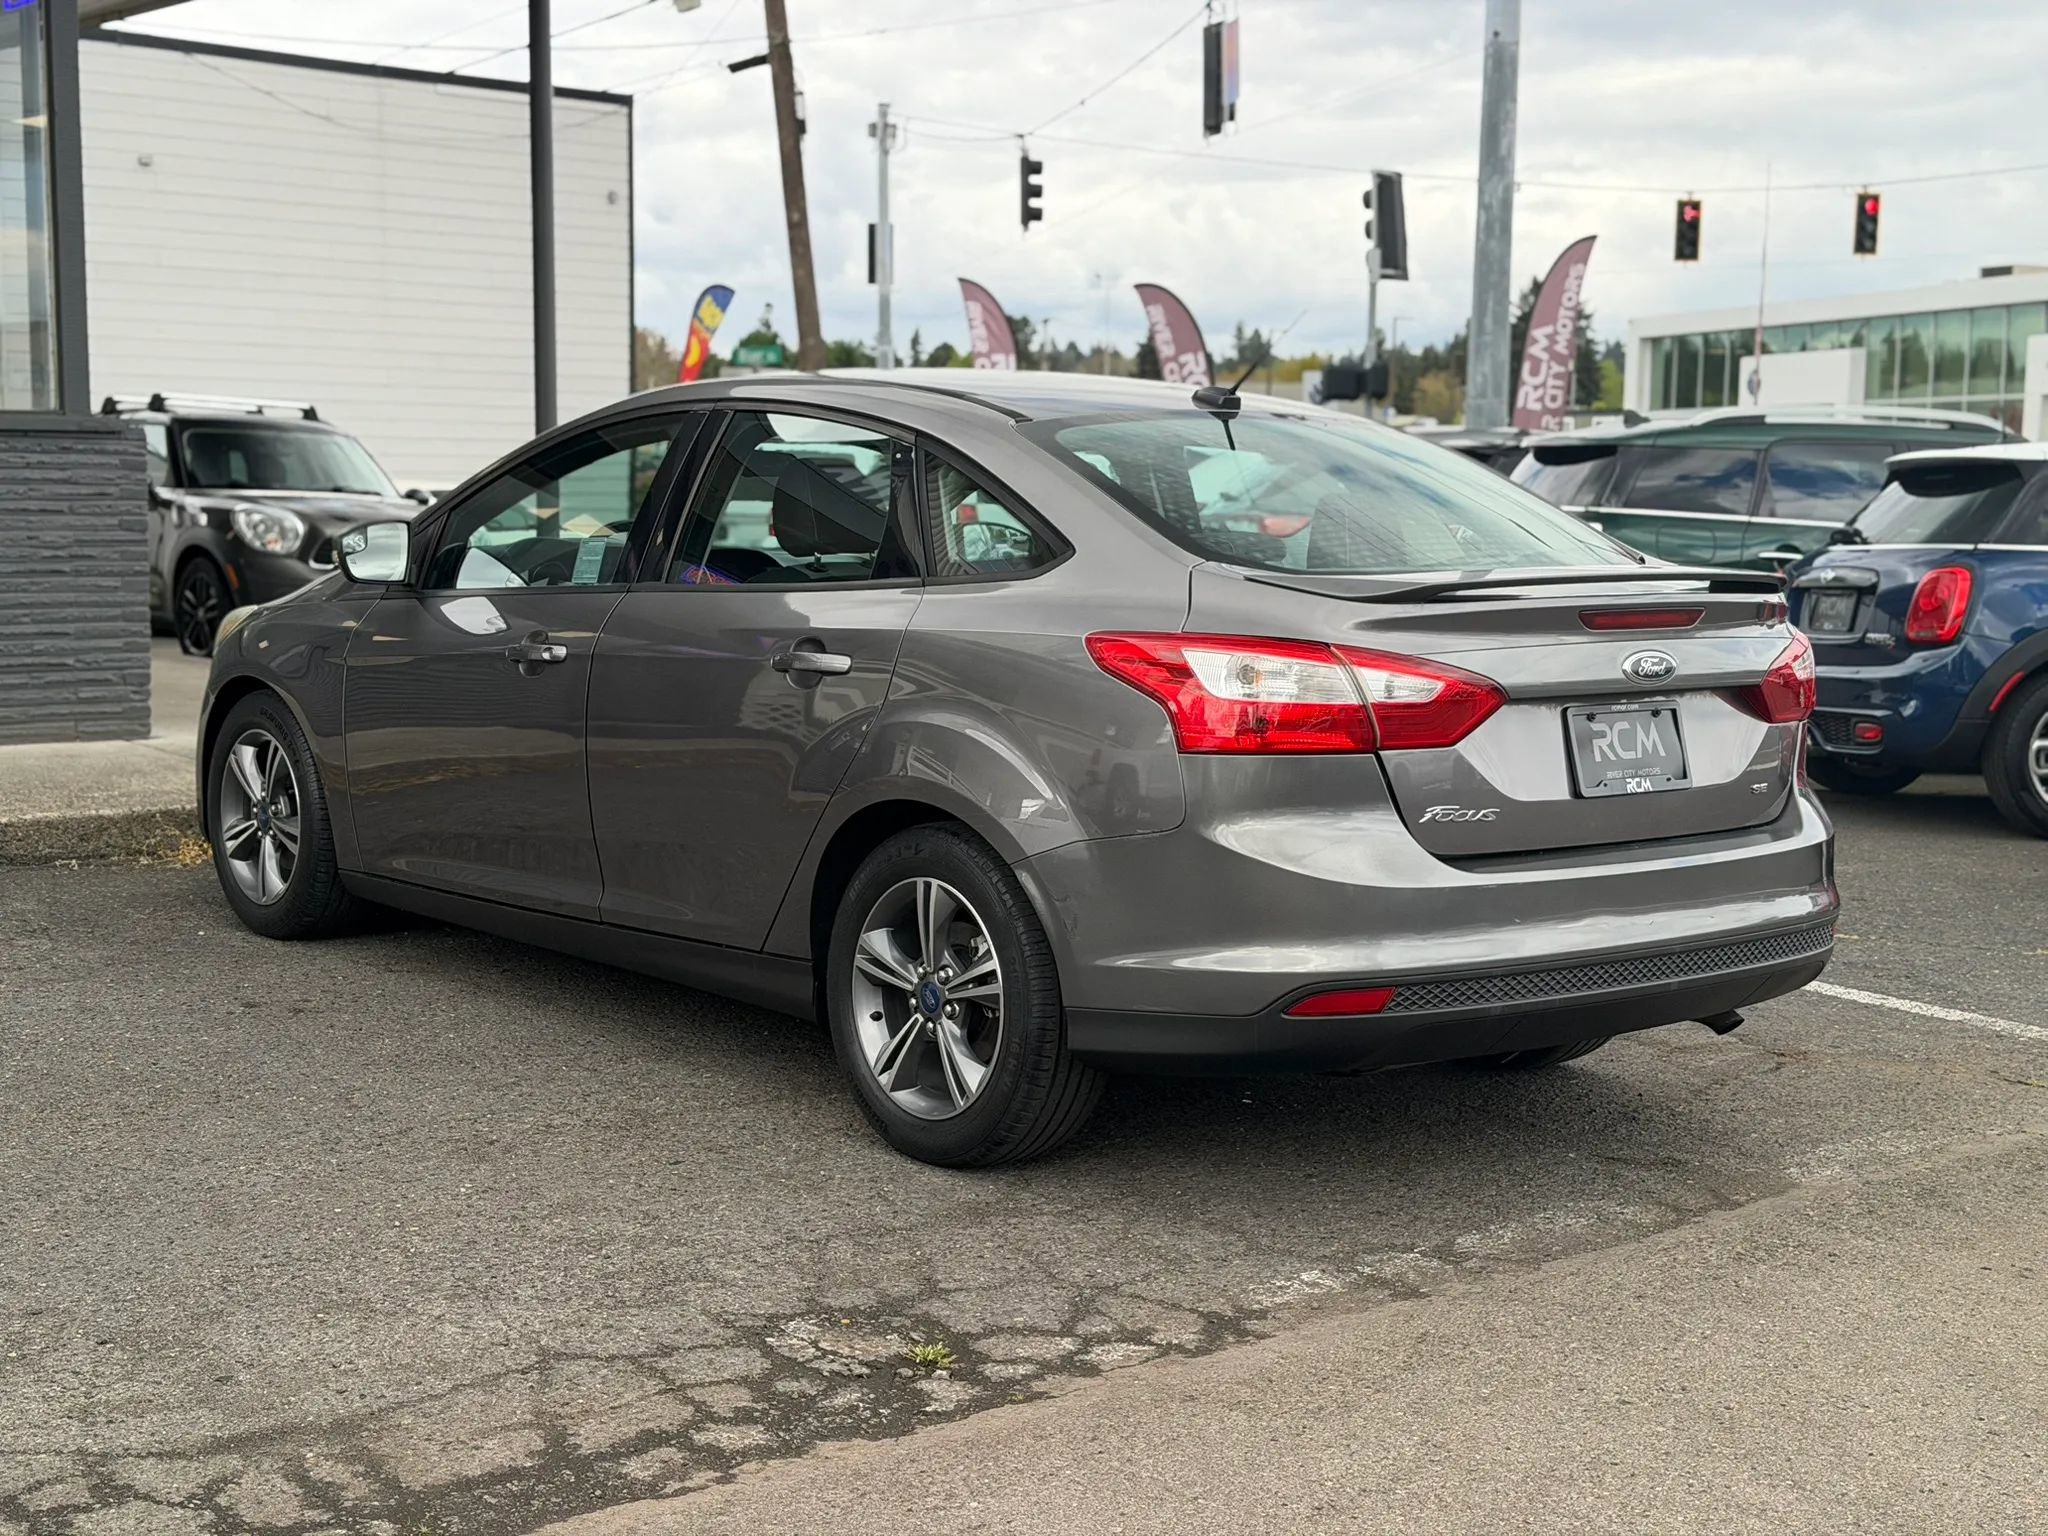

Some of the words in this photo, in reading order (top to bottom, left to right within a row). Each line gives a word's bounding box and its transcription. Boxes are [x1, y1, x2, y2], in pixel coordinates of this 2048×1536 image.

[1554, 262, 1584, 355] MOTORS
[1517, 324, 1554, 411] RCM
[1544, 361, 1566, 409] CITY
[1638, 657, 1667, 676] Ford
[1590, 720, 1666, 762] RCM
[1623, 769, 1636, 777] CITY
[1637, 767, 1661, 776] MOTORS
[1625, 777, 1653, 793] RCM
[1750, 783, 1769, 794] SE
